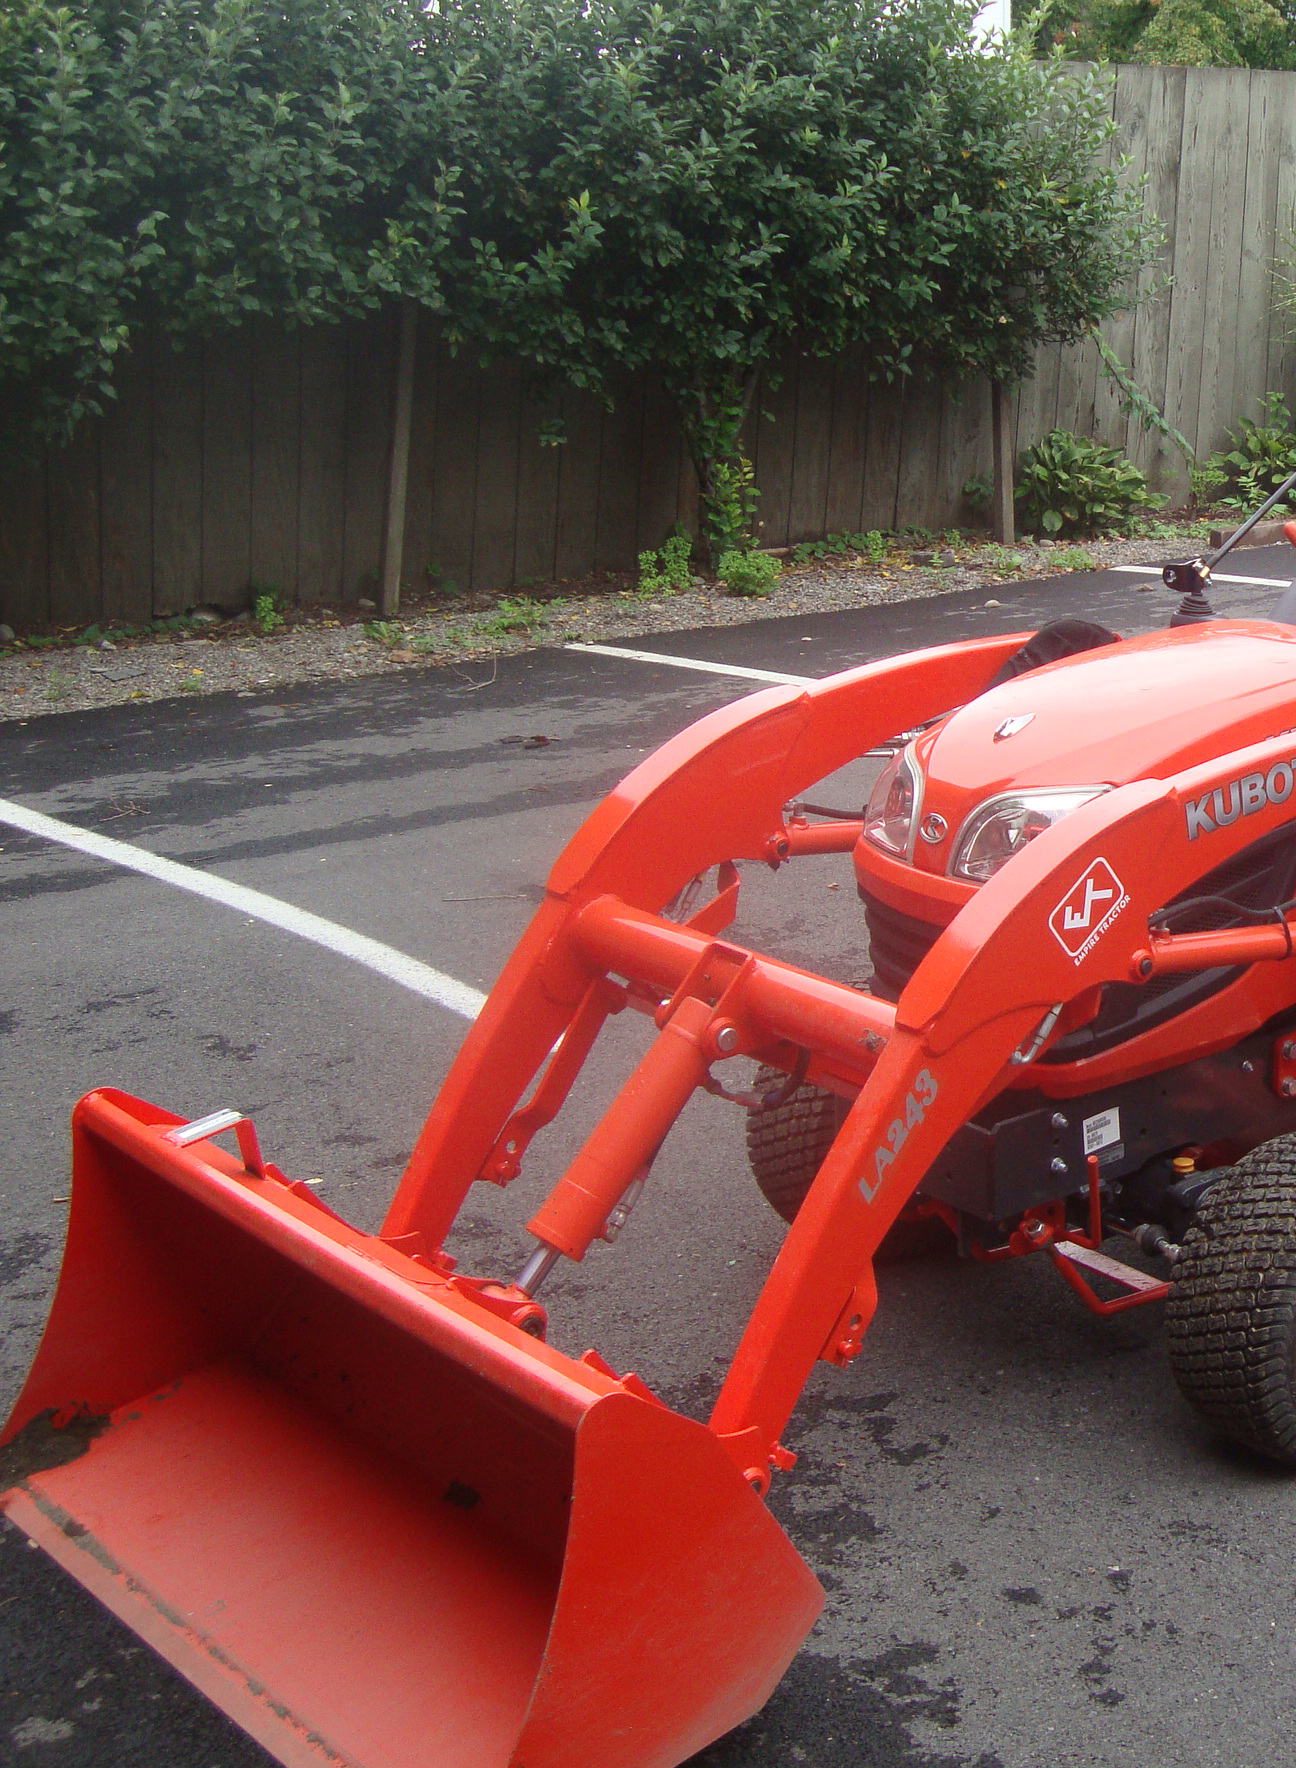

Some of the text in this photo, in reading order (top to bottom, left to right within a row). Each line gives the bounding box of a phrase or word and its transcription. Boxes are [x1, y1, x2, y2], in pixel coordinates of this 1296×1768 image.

[1073, 894, 1132, 967] EMPIRE TRACTOR
[858, 1068, 938, 1204] LA243
